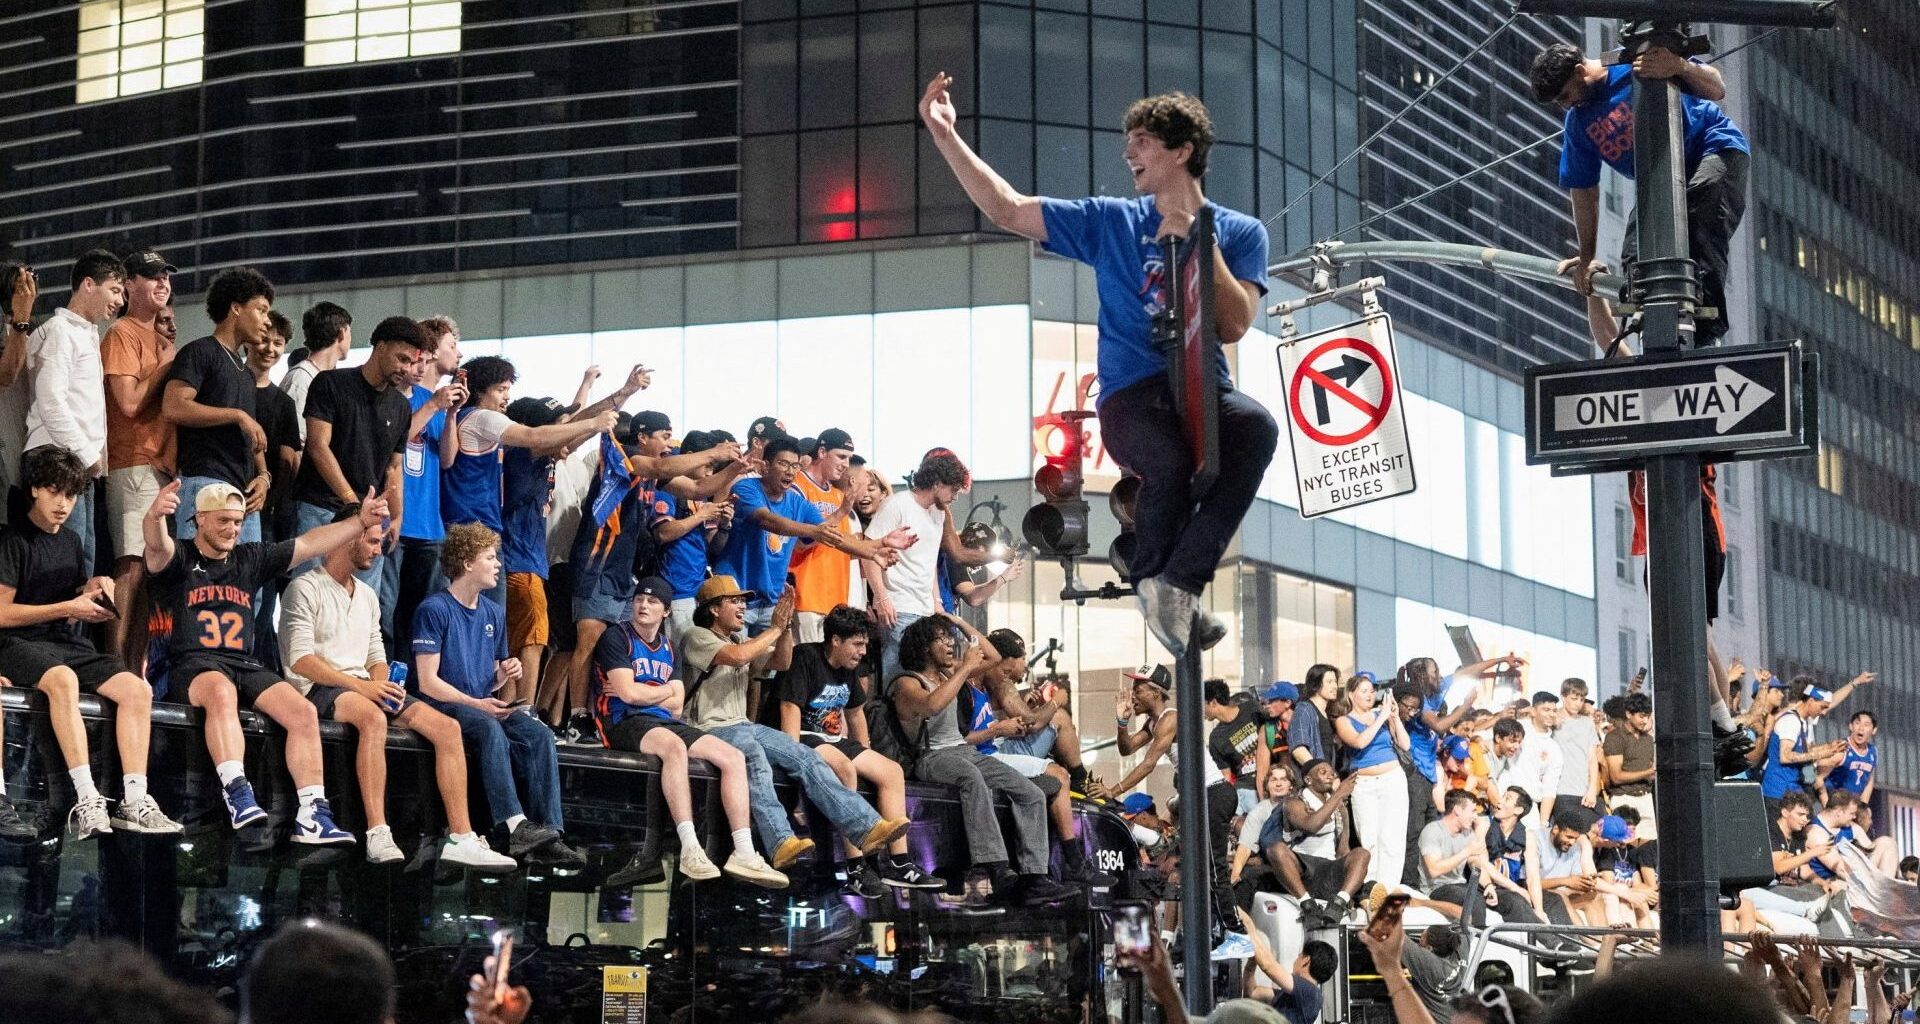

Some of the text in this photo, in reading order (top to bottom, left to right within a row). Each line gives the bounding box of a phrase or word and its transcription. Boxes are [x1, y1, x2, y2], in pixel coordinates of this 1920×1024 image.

[1576, 382, 1749, 426] ONE WAY
[1322, 442, 1380, 469] EXCEPT
[1304, 454, 1404, 492] NYC TRANSIT
[1331, 479, 1383, 503] BUSES
[197, 610, 244, 650] 32
[1096, 849, 1125, 871] 1364
